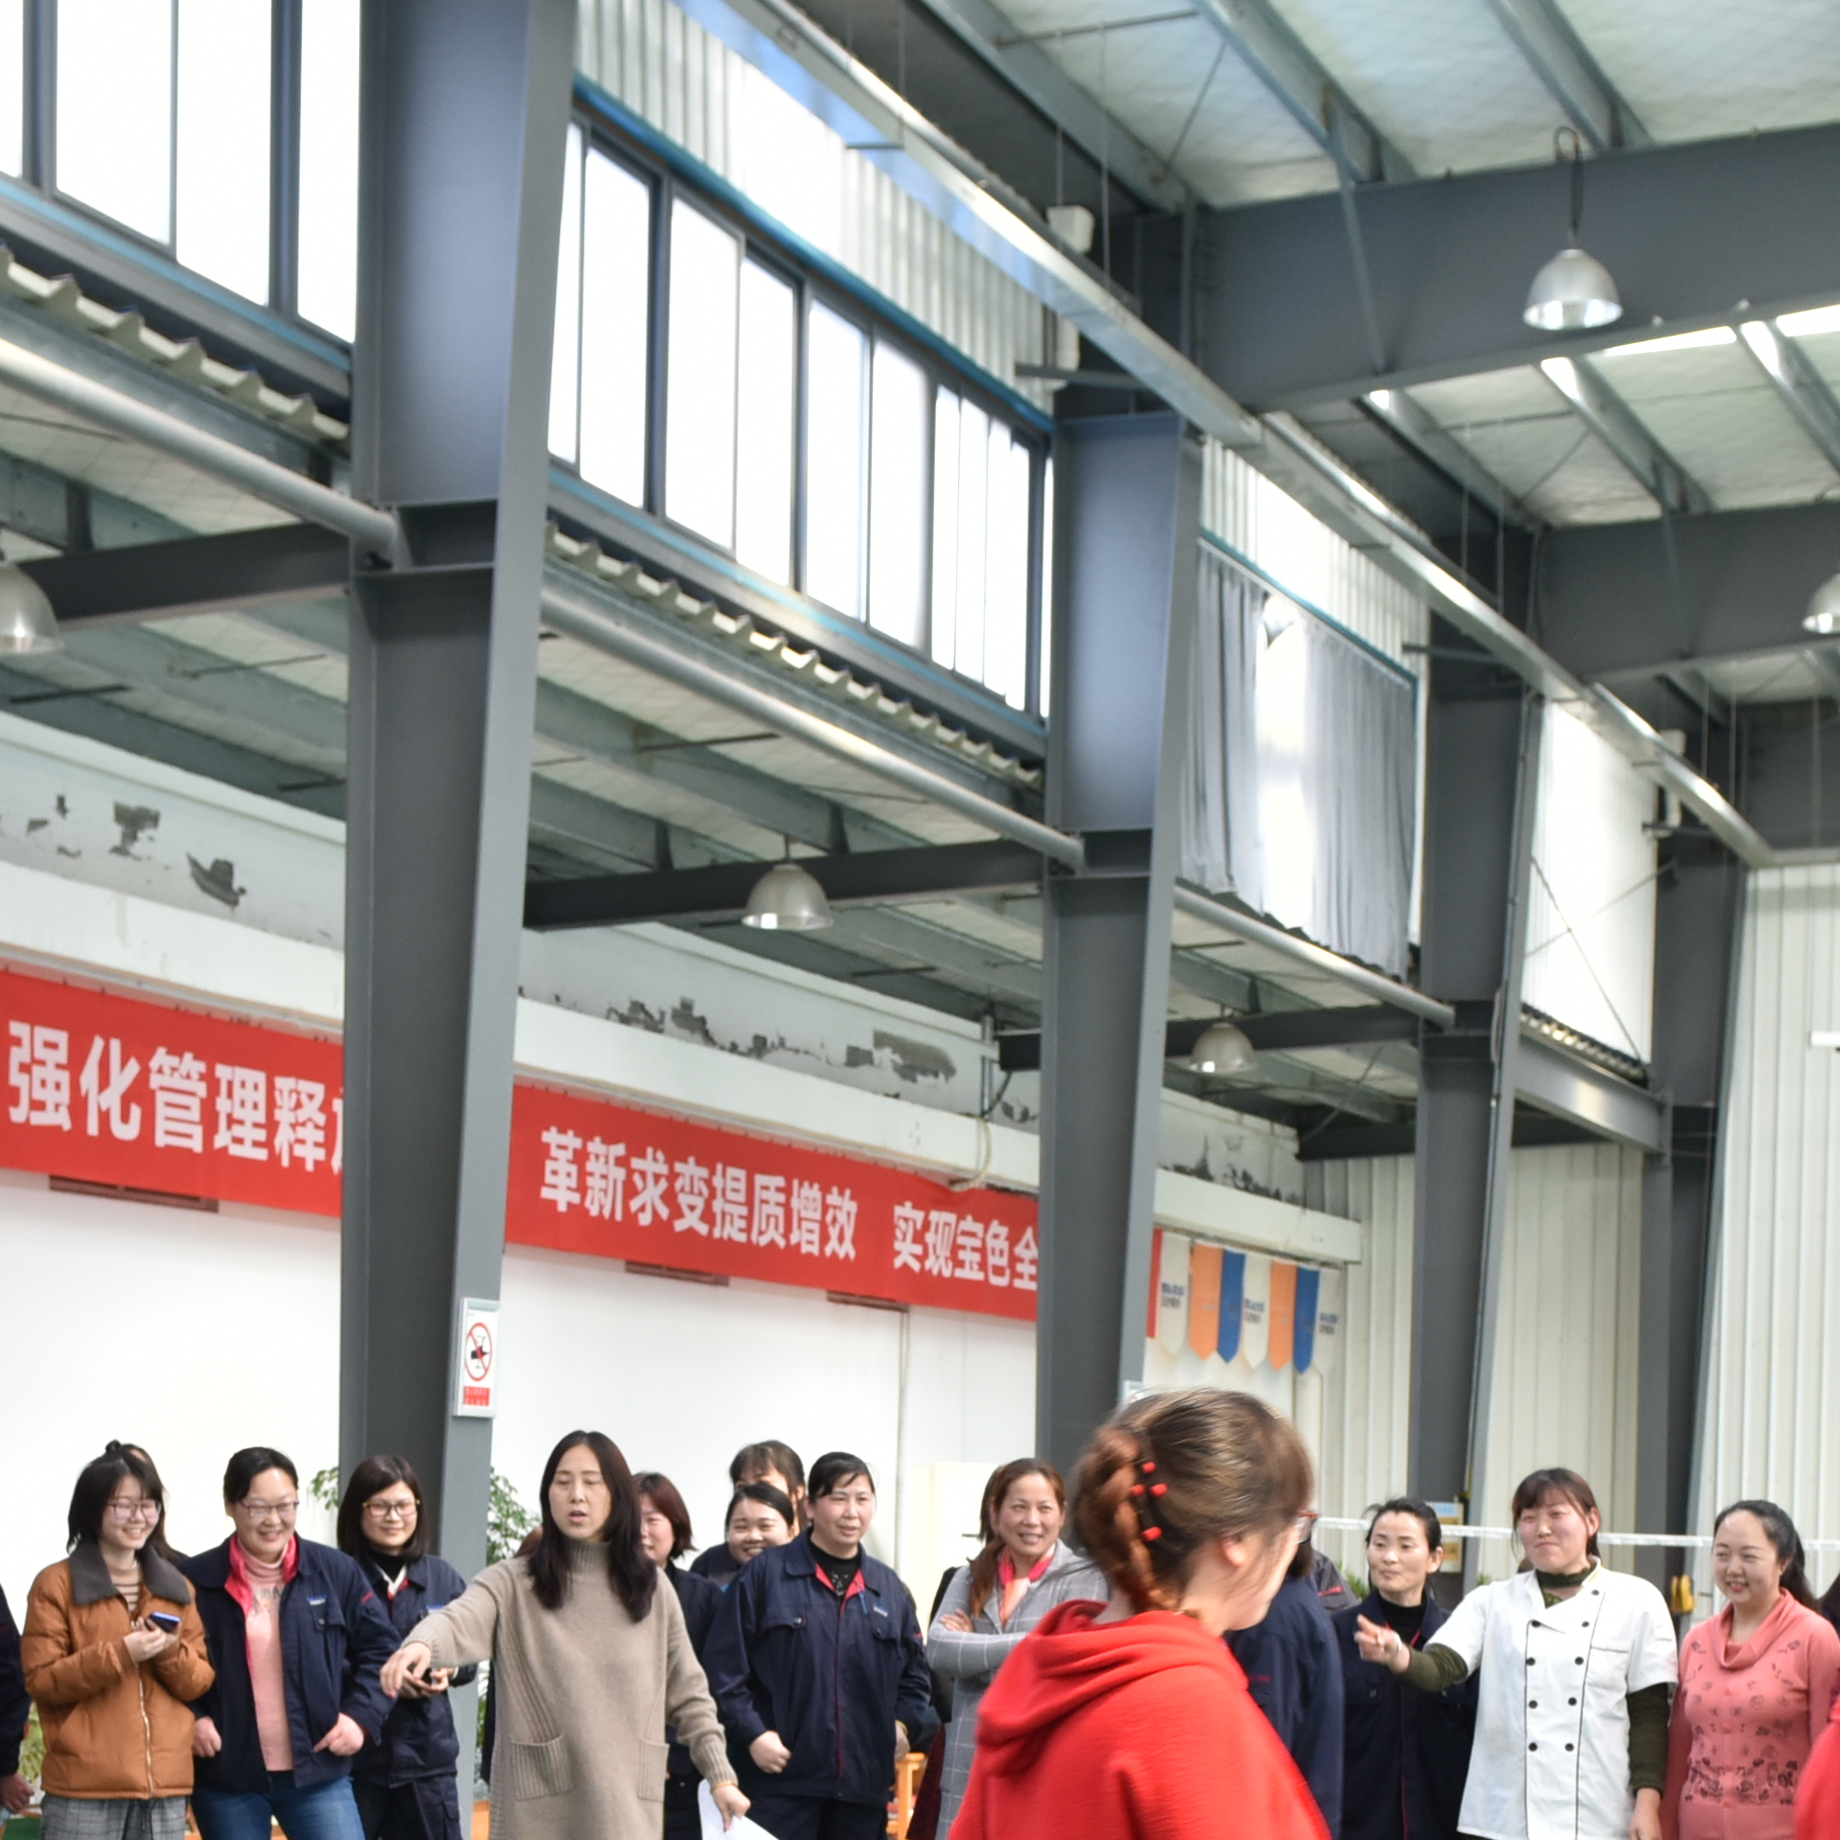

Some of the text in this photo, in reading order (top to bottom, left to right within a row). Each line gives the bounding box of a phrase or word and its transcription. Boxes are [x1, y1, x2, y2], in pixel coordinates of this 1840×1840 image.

[9, 1021, 342, 1174] 强化管理释
[540, 1126, 1038, 1291] 革新求变提质增效 实现宝色全
